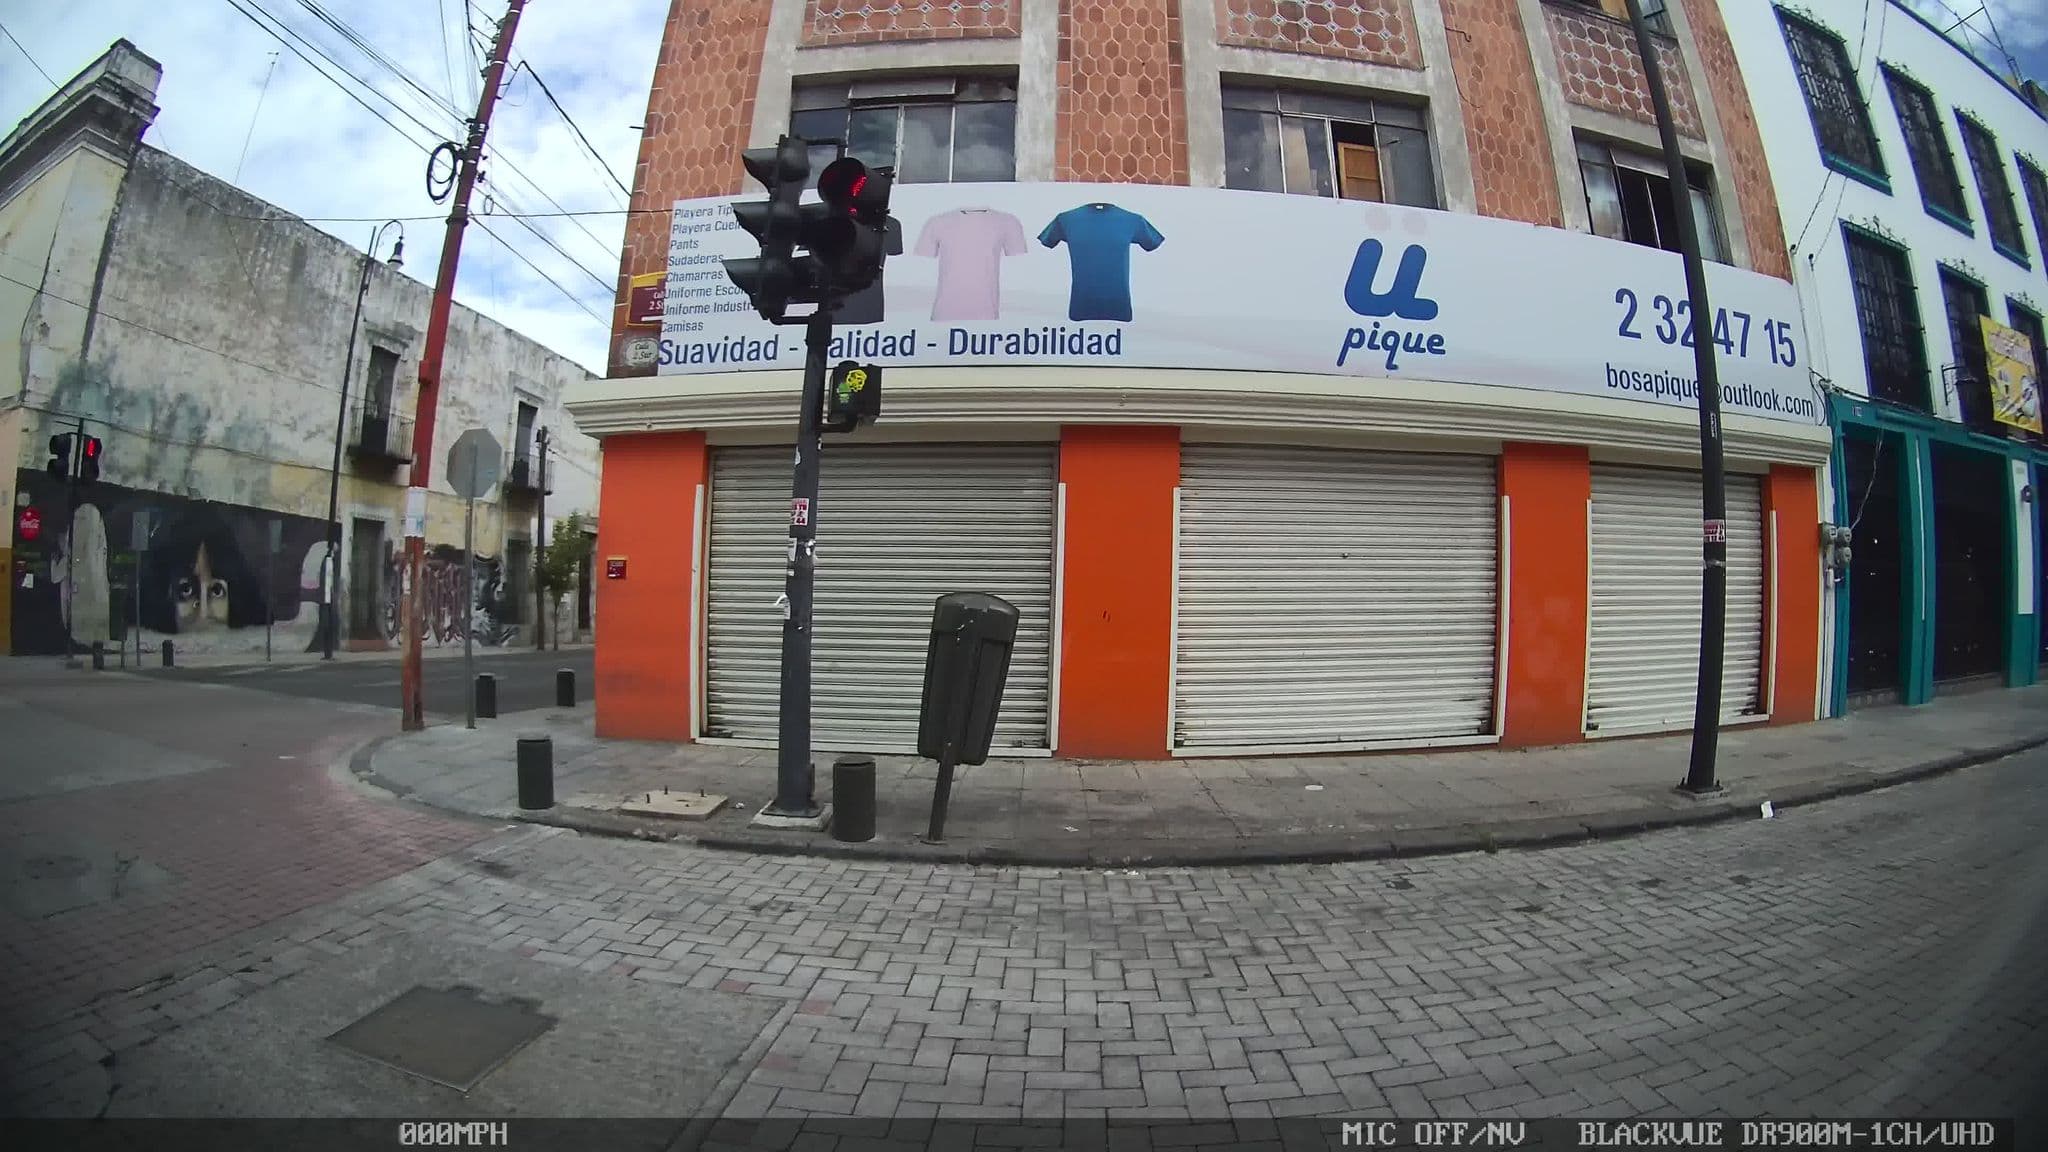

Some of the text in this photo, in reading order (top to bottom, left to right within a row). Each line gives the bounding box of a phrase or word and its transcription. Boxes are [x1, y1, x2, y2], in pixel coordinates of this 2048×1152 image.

[674, 204, 734, 219] Playera Tip
[672, 222, 712, 235] Playera
[670, 238, 699, 250] Pants
[668, 254, 724, 267] Sudaderas
[667, 269, 724, 282] Chamarras
[665, 286, 712, 299] Uniforme
[663, 300, 751, 316] Uniforme Industr
[661, 320, 704, 333] Camisas
[1615, 287, 1797, 368] 2 32 47 15
[658, 333, 779, 365] Suavidad
[829, 328, 917, 359] alidad
[948, 326, 1122, 356] Durabilidad
[1336, 321, 1446, 371] pique
[1606, 361, 1815, 418] bosapiqueoutlook.com
